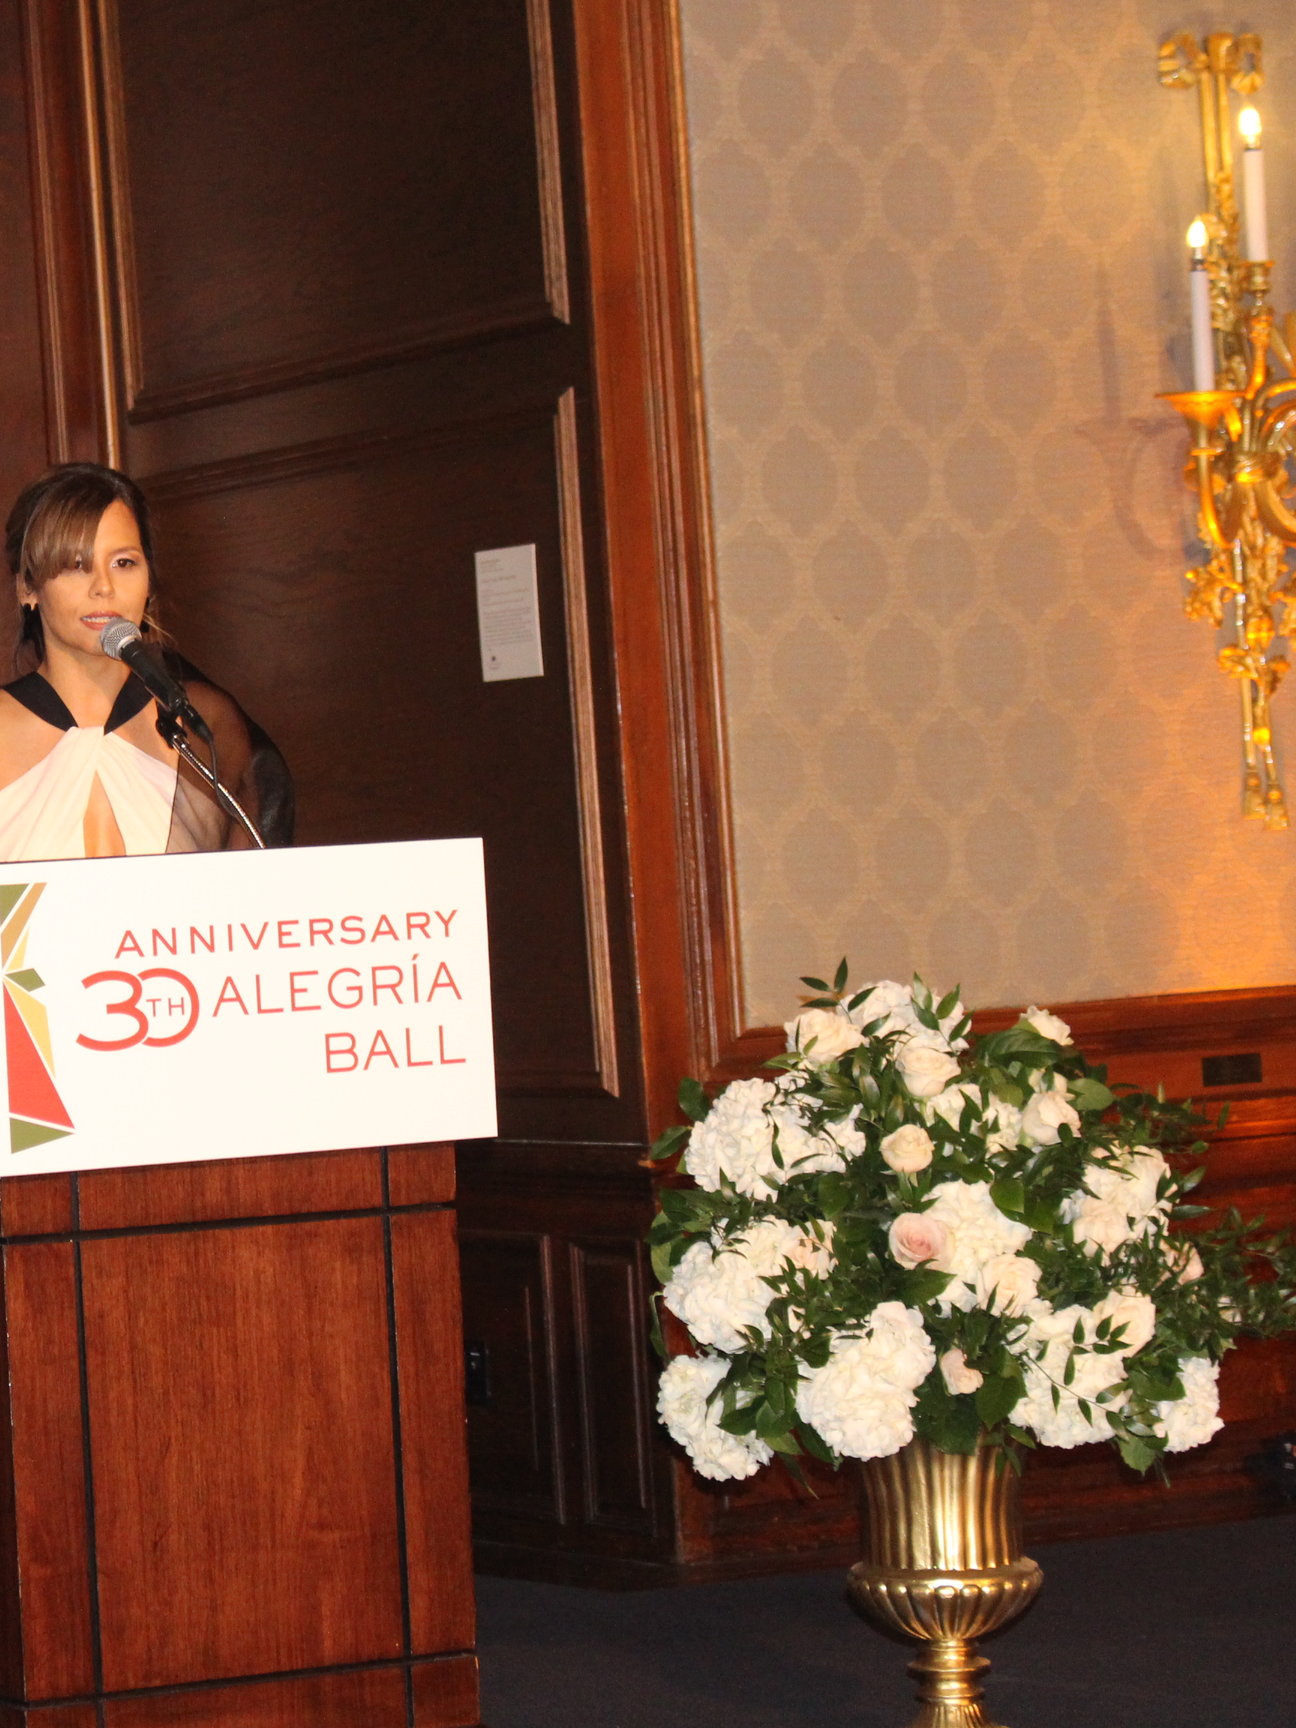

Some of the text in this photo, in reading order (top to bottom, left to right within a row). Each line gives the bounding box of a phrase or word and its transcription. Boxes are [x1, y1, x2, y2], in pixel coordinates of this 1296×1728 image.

[115, 909, 458, 959] ANNIVERSARY
[212, 953, 463, 1018] ALEGRÍA
[324, 1024, 467, 1074] BALL
